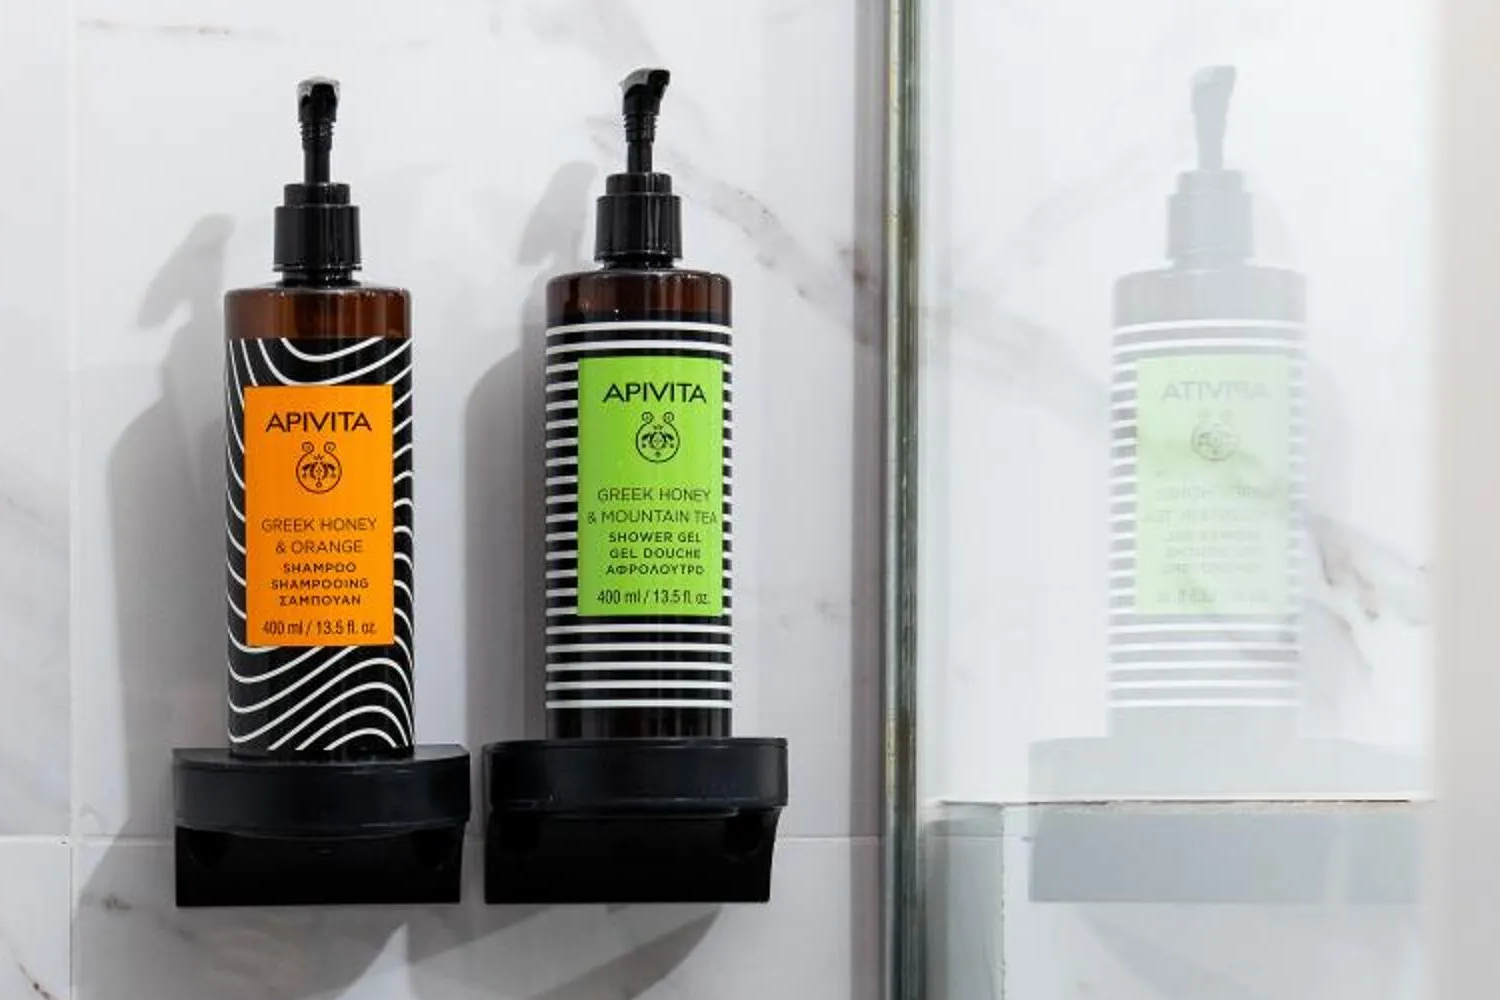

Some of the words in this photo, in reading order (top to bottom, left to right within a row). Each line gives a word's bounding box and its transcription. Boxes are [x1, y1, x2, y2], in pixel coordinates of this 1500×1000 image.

[603, 382, 707, 404] APIVITA
[265, 411, 372, 432] APIVITA
[597, 487, 653, 501] GREEK
[659, 487, 711, 501] HONEY
[587, 511, 597, 525] &
[601, 509, 690, 524] MOUNTAIN
[694, 510, 717, 525] TEA
[261, 518, 315, 533] GREEK
[320, 517, 377, 532] HONEY
[608, 531, 673, 543] SHOWER
[677, 531, 701, 543] GEL
[275, 542, 286, 554] &
[291, 540, 363, 554] ORANGE
[609, 547, 638, 559] GEL
[643, 547, 701, 559] DOUCHE
[283, 562, 356, 573] SHAMPOO
[270, 578, 369, 590] SHAMPOOING
[279, 594, 361, 607] ΣΑΜΠΟΥΑΝ
[596, 588, 621, 604] 400
[625, 588, 641, 604] ml
[653, 588, 681, 605] 13.5
[261, 620, 284, 635] 400
[287, 619, 303, 635] ml
[316, 619, 345, 635] 13.5
